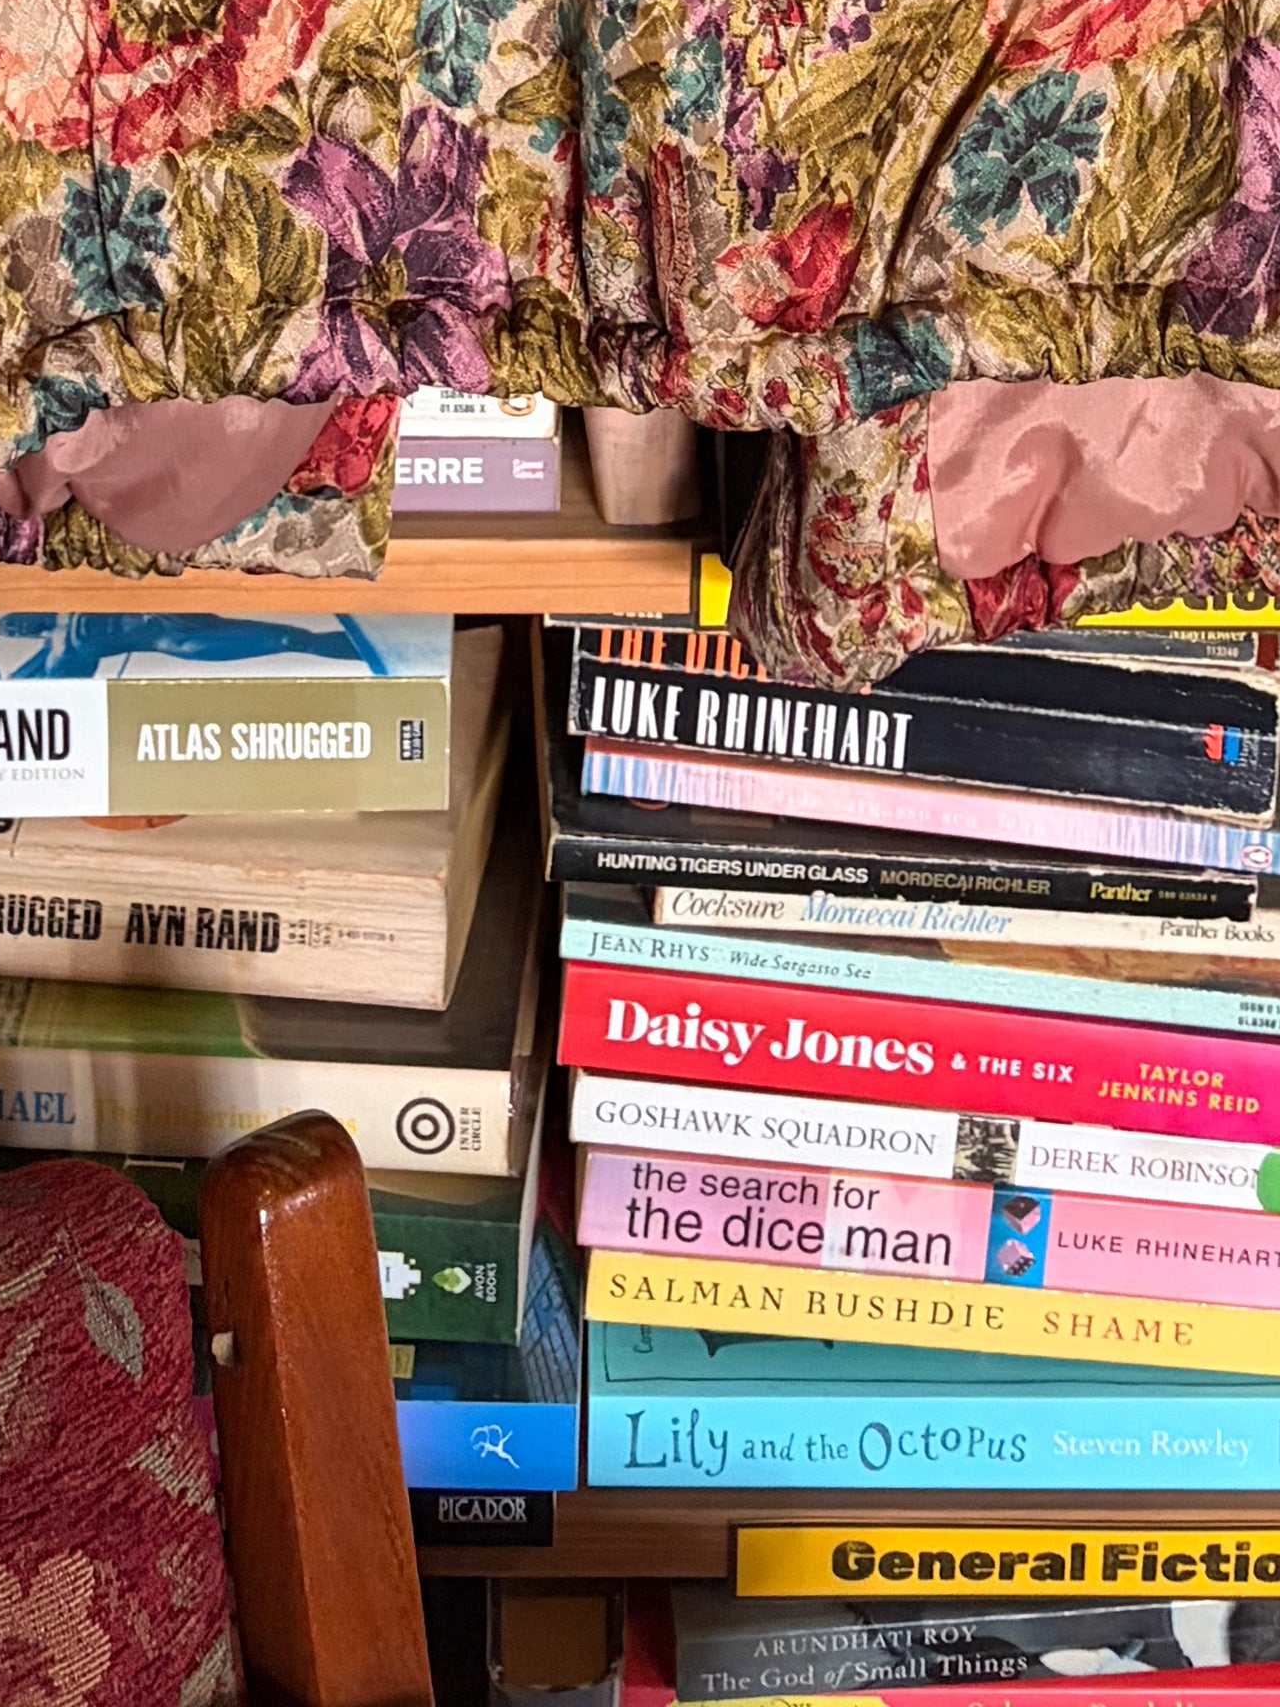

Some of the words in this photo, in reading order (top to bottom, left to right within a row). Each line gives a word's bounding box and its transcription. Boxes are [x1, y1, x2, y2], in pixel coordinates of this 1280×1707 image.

[137, 723, 223, 761] ATLAS
[230, 721, 372, 761] SHRUGGED
[596, 853, 678, 875] HUNTING
[679, 858, 744, 877] TIGERS
[744, 859, 806, 882] UNDER
[807, 863, 869, 884] GLASS
[604, 998, 765, 1066] Daisy
[769, 1018, 935, 1076] Jones
[1098, 1077, 1201, 1108] JENKINS
[1208, 1094, 1260, 1114] REID
[1139, 1063, 1225, 1088] TAYLOR
[624, 1198, 704, 1243] the
[721, 1207, 825, 1253] dice
[843, 1218, 952, 1267] man
[1057, 1230, 1122, 1254] LUKE
[609, 1273, 784, 1312] SALMAN
[806, 1288, 1007, 1332] RUSHDIE
[1042, 1309, 1195, 1347] SHAME
[623, 1408, 731, 1477] Lily
[742, 1434, 794, 1463] and
[804, 1434, 849, 1463] the
[831, 1540, 1087, 1583] General
